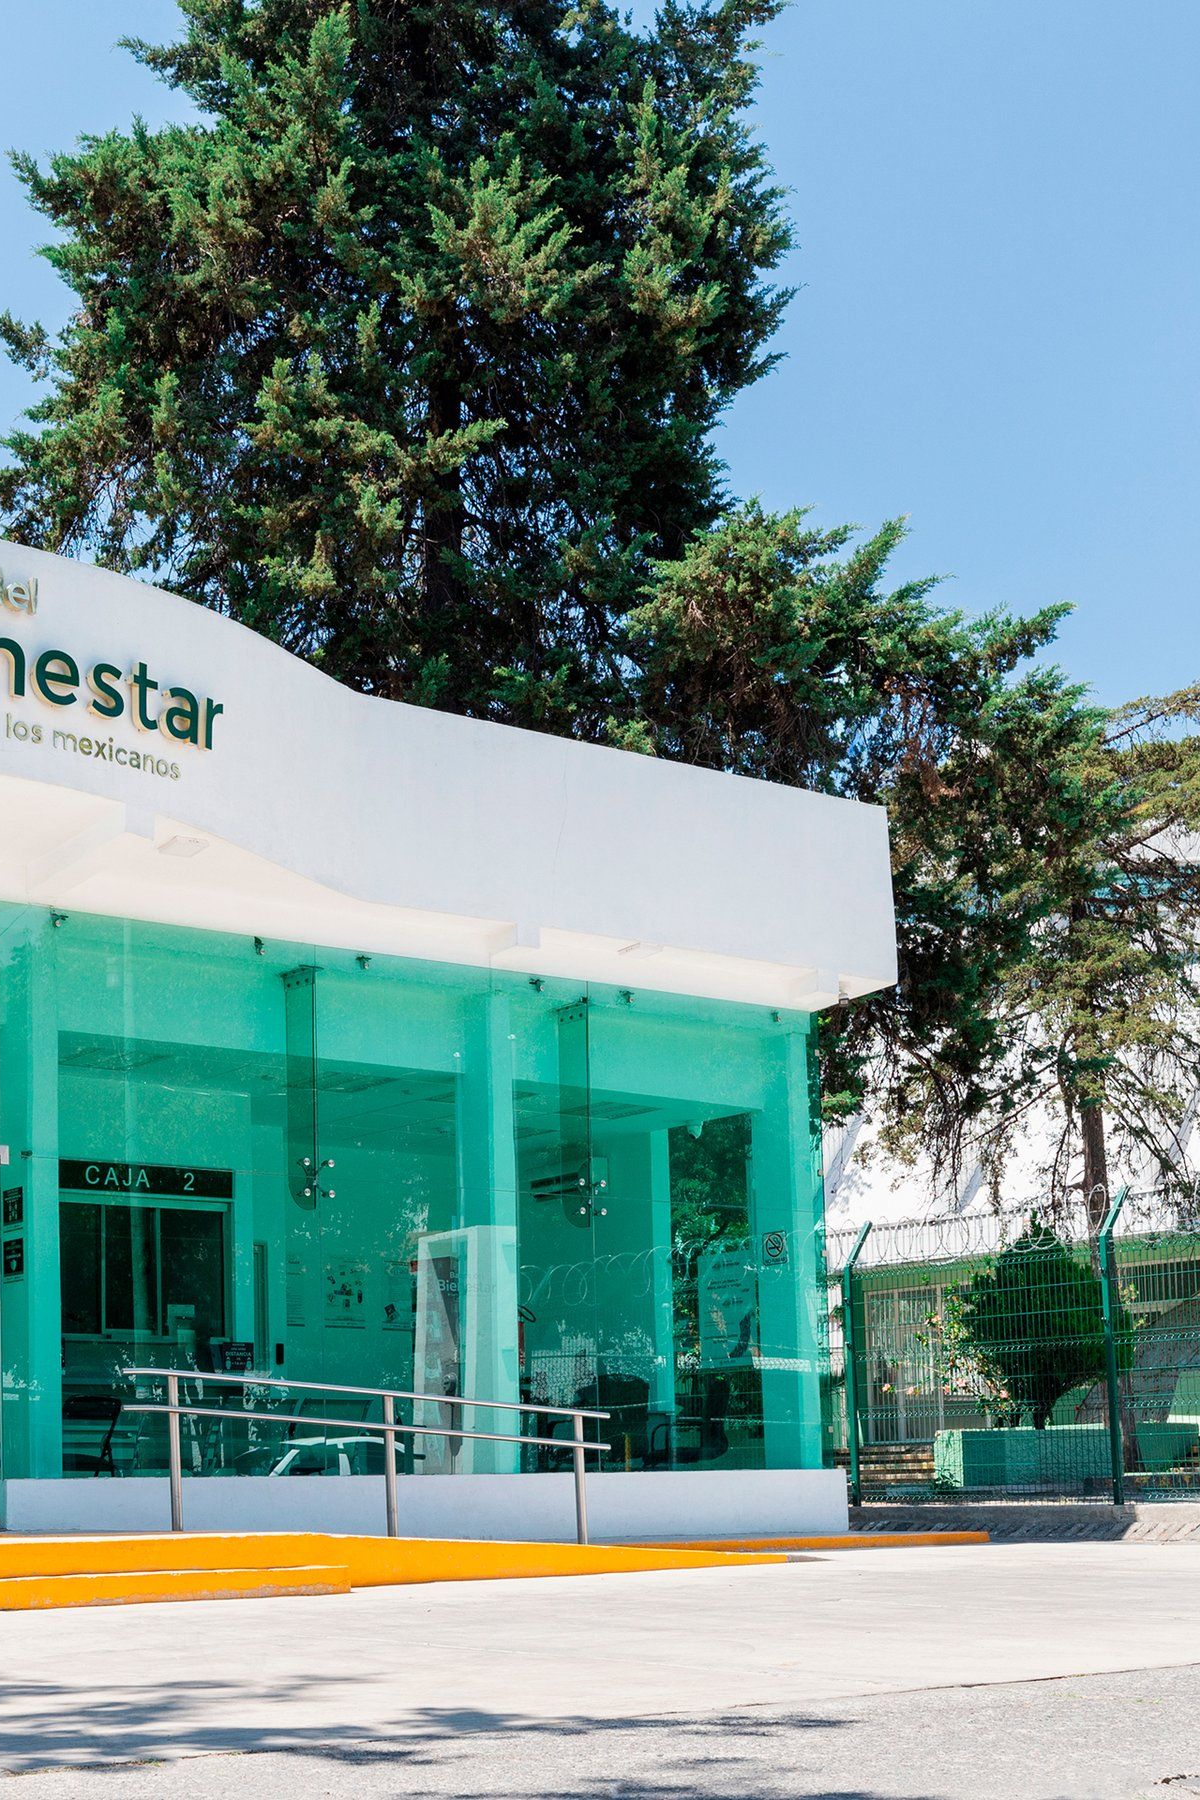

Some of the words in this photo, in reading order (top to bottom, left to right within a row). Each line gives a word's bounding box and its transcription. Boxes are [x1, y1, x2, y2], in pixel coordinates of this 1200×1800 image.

[6, 712, 43, 744] los
[51, 728, 182, 781] mexicanos
[85, 1165, 150, 1188] CAJA
[183, 1172, 195, 1191] 2
